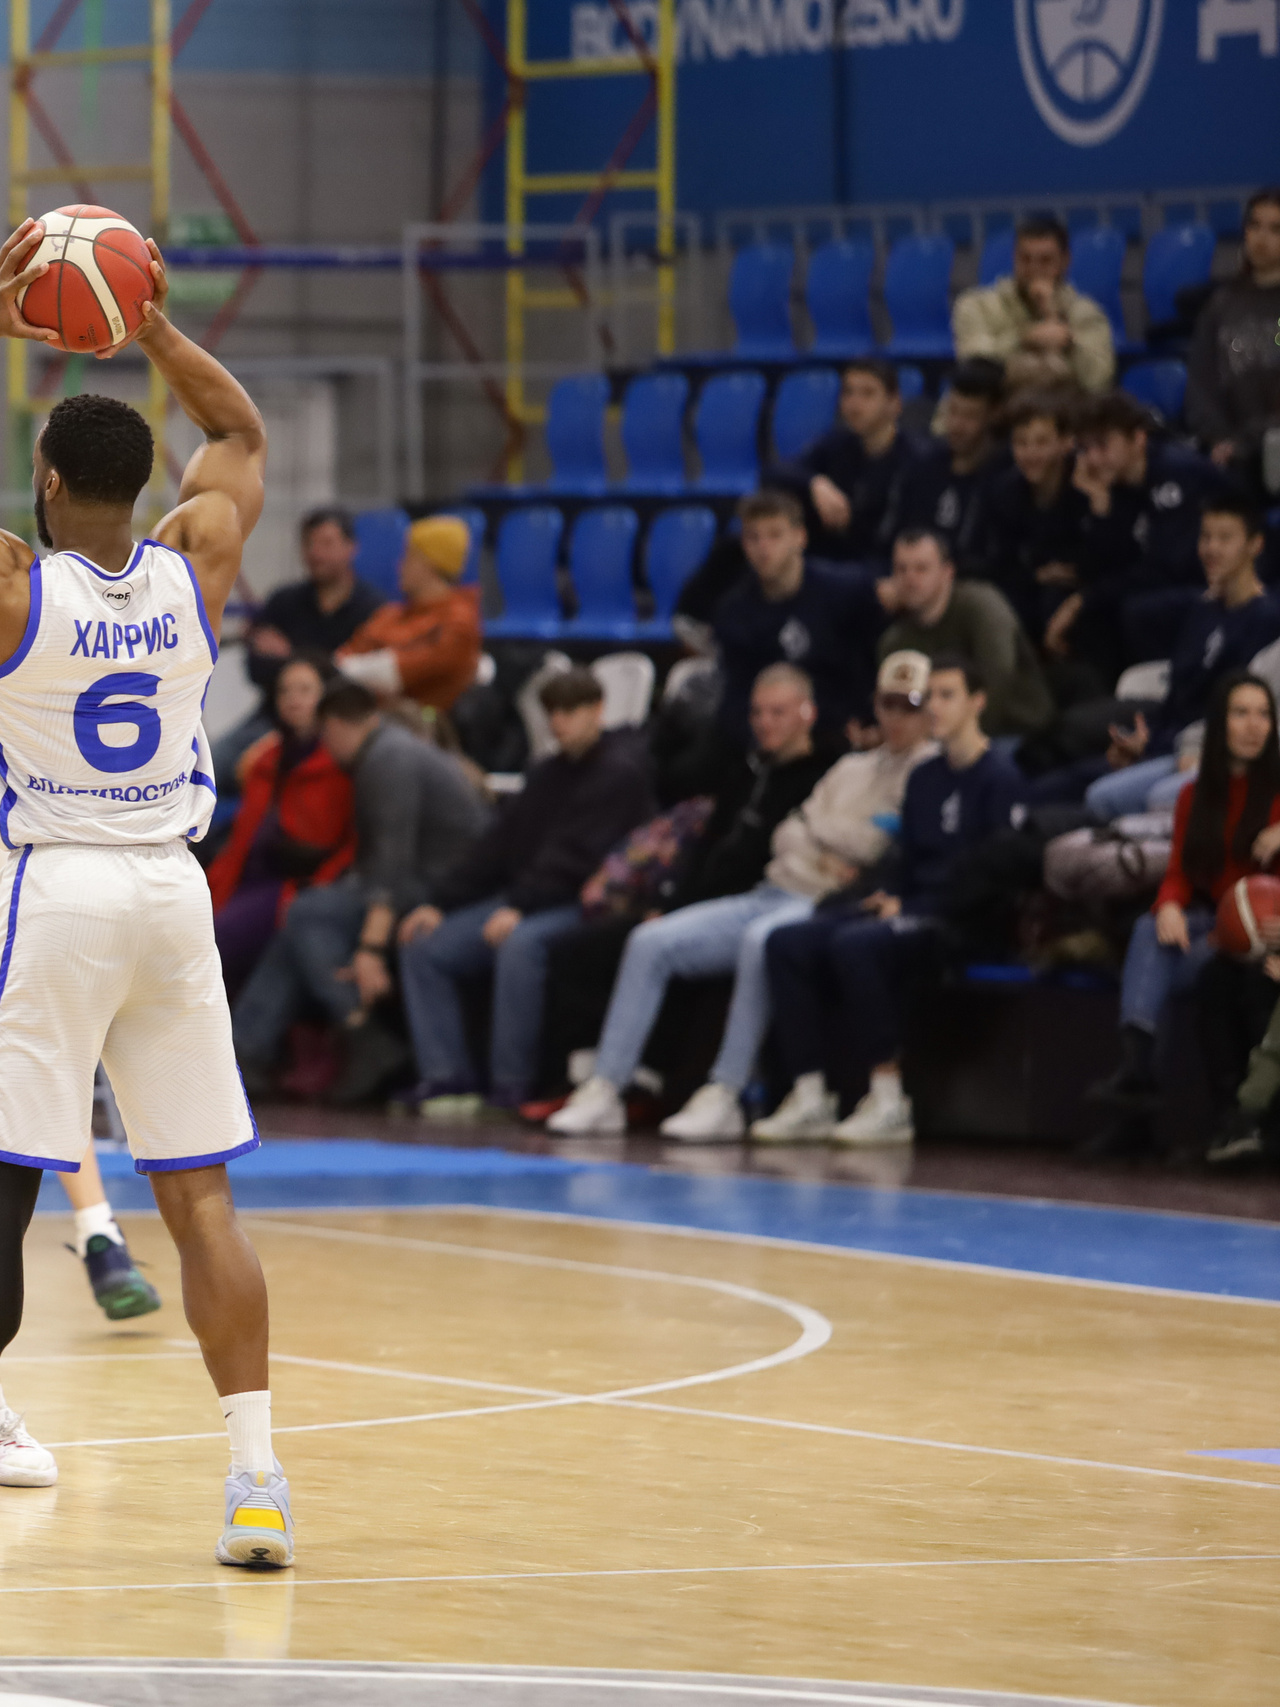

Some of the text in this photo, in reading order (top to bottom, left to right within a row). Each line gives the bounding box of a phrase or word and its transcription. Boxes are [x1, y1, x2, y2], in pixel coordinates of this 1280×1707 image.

[70, 613, 178, 659] ХАРРИС
[73, 672, 162, 773] 6
[27, 771, 188, 802] ВЛАИВОСТОК
